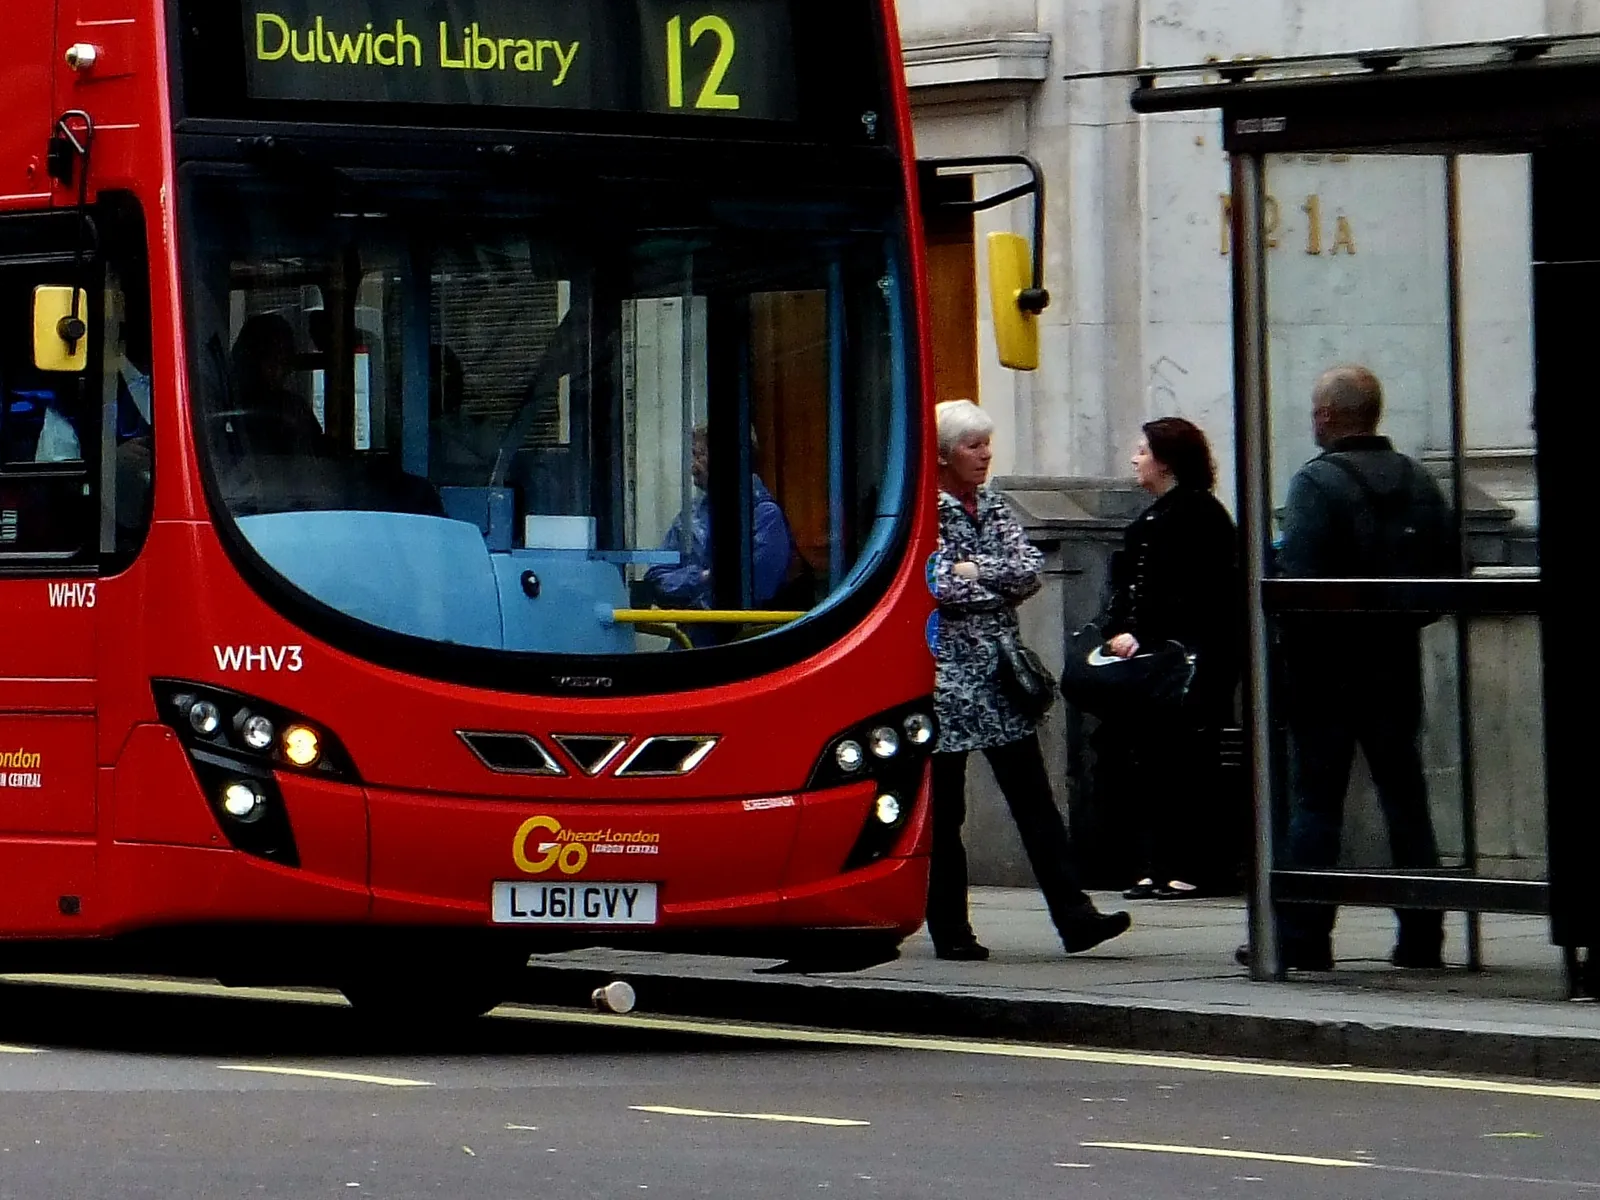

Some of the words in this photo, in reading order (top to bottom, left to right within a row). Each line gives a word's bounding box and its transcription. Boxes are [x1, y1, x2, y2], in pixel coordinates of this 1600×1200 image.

[255, 12, 422, 68] Dulwich
[439, 20, 581, 87] Library
[666, 14, 740, 110] 12
[48, 583, 96, 608] WHV3
[212, 644, 303, 672] WHV3
[8, 772, 42, 788] CENTRAL
[512, 814, 589, 875] Go
[556, 828, 660, 844] Ahead-London
[591, 843, 624, 854] LONDON
[626, 844, 659, 855] CENTRAL
[510, 886, 575, 919] LJ61
[582, 887, 639, 918] GVY
